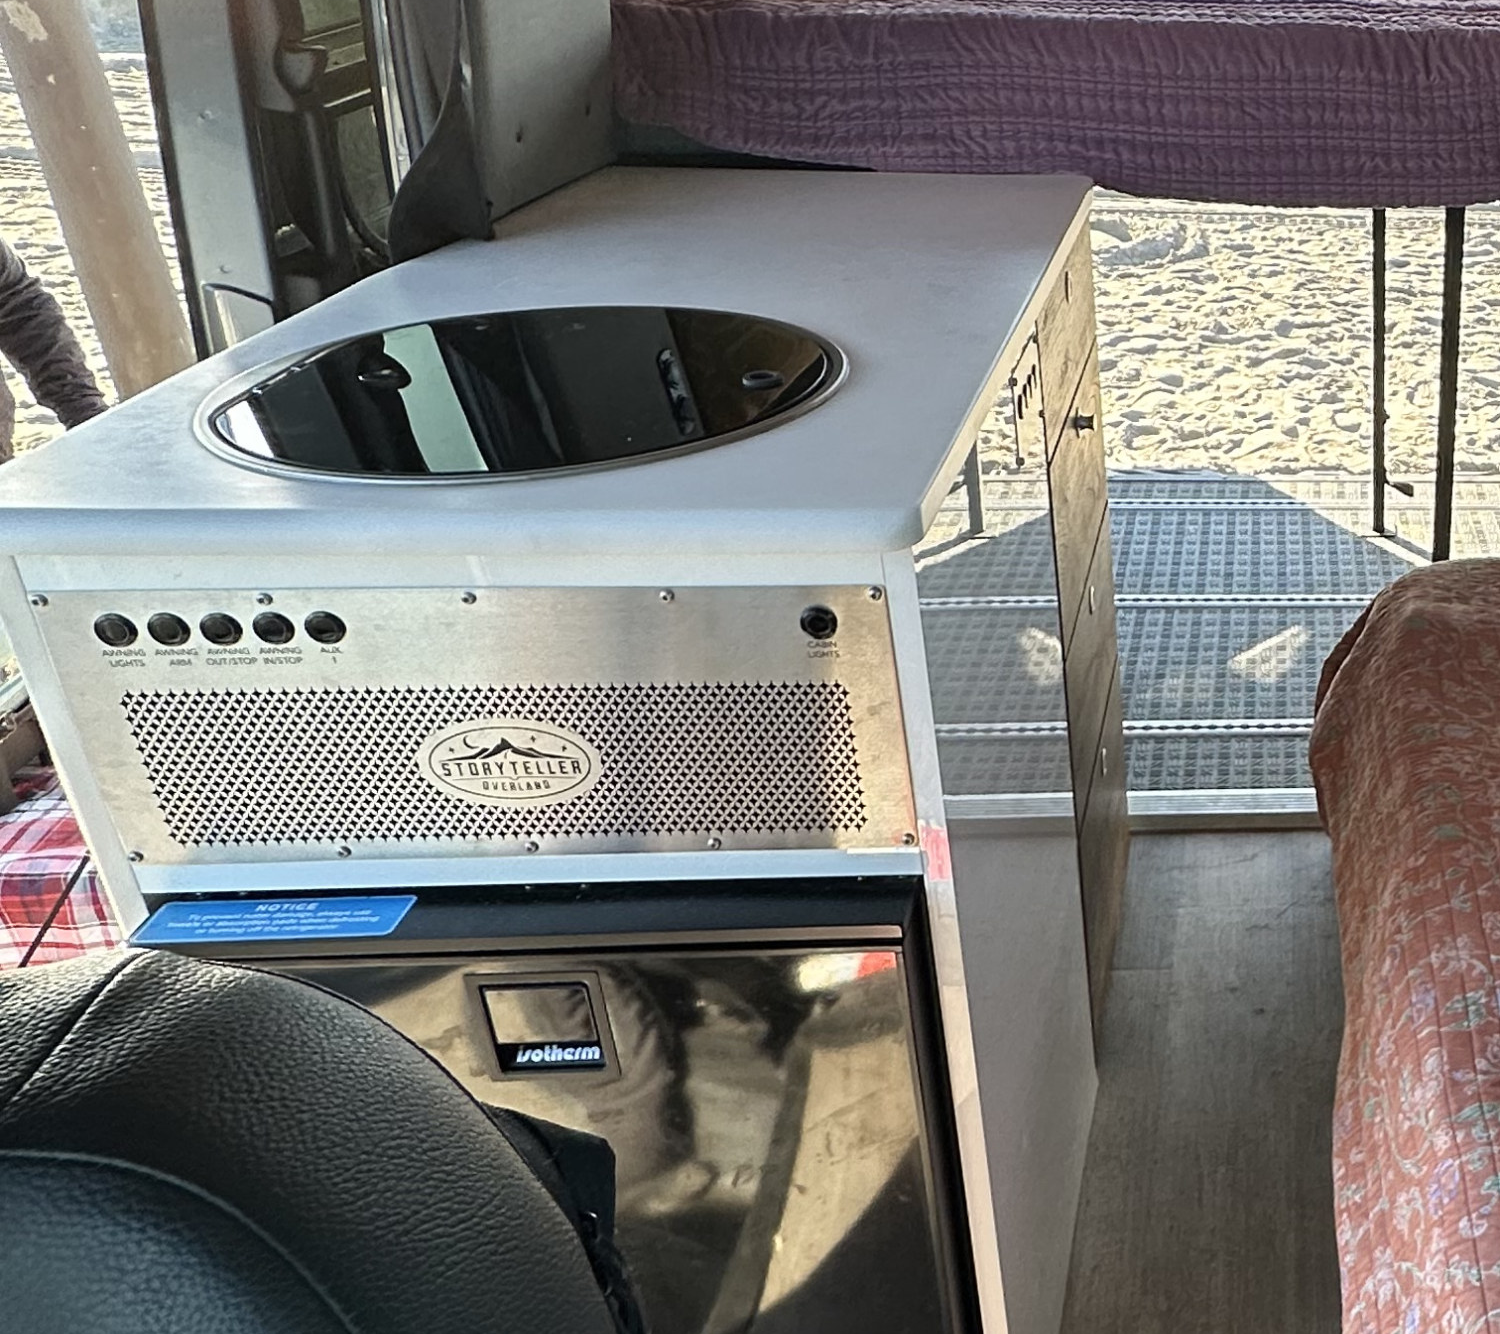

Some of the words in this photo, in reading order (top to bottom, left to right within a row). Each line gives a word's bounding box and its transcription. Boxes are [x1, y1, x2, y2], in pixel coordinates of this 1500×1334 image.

[807, 640, 837, 648] CABIN
[102, 649, 146, 657] AWNING
[155, 648, 199, 656] AWNING
[808, 650, 840, 658] LIGHTS
[109, 659, 146, 667] LIGHTS
[205, 657, 258, 665] OUT/STOP
[263, 656, 303, 665] IN/STOP
[441, 760, 582, 777] STORYTELLER
[482, 780, 551, 792] OVERLAND
[255, 902, 319, 912] NOTICE
[516, 1044, 600, 1063] isotherm
